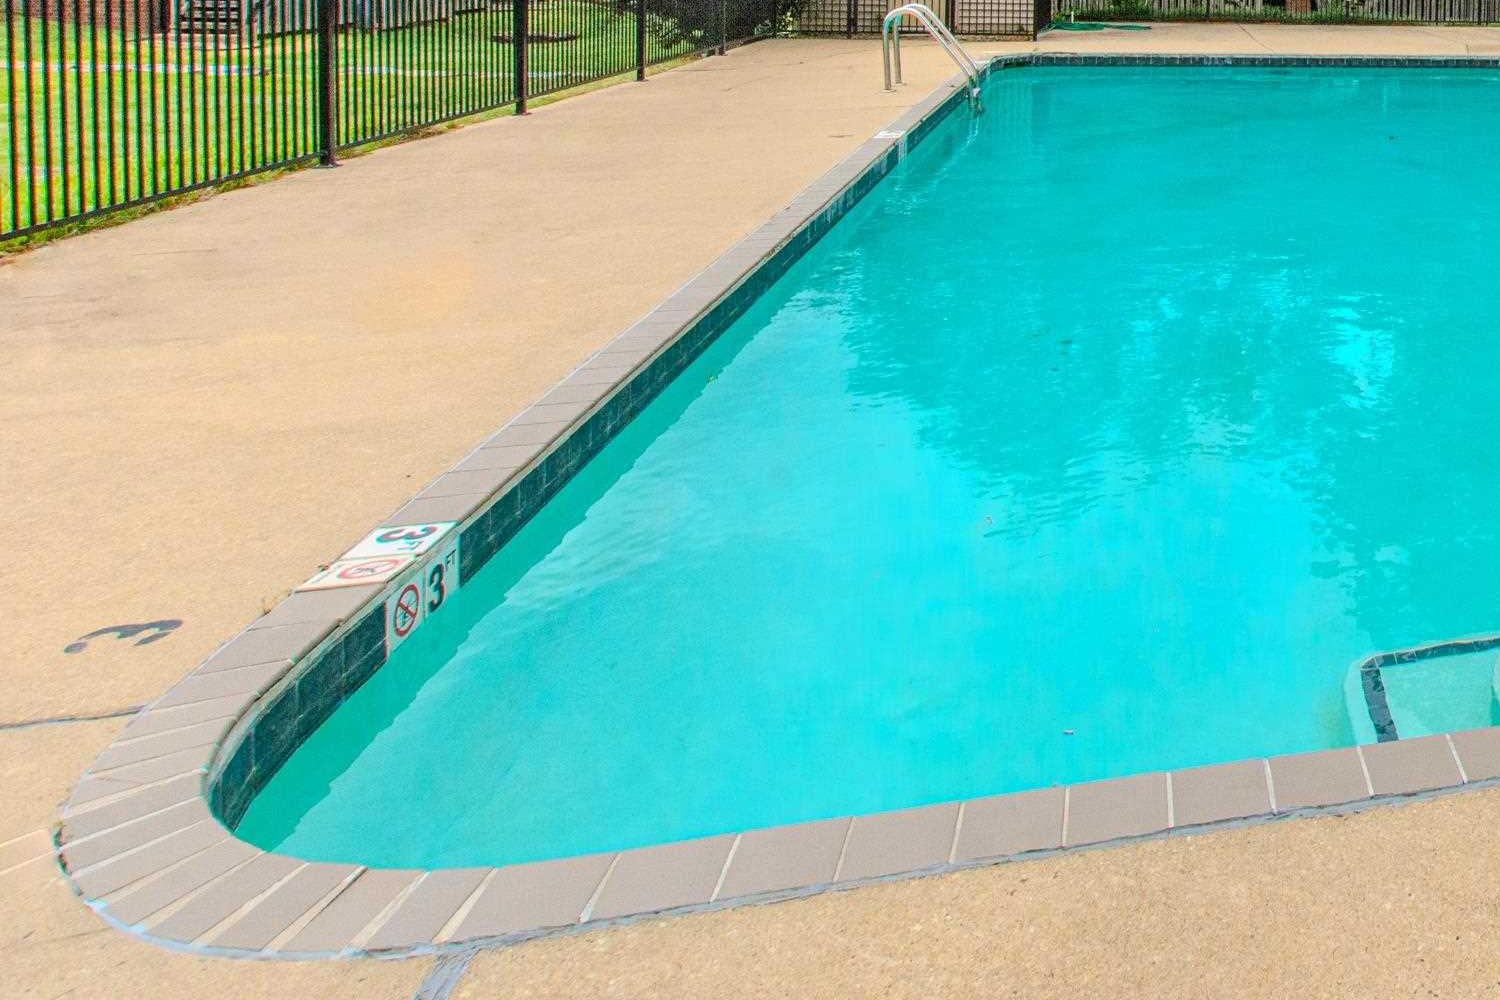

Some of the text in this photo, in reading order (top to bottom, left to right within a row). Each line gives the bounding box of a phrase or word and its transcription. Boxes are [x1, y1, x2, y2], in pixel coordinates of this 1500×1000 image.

[376, 526, 438, 544] 3
[429, 548, 457, 613] 3 FT
